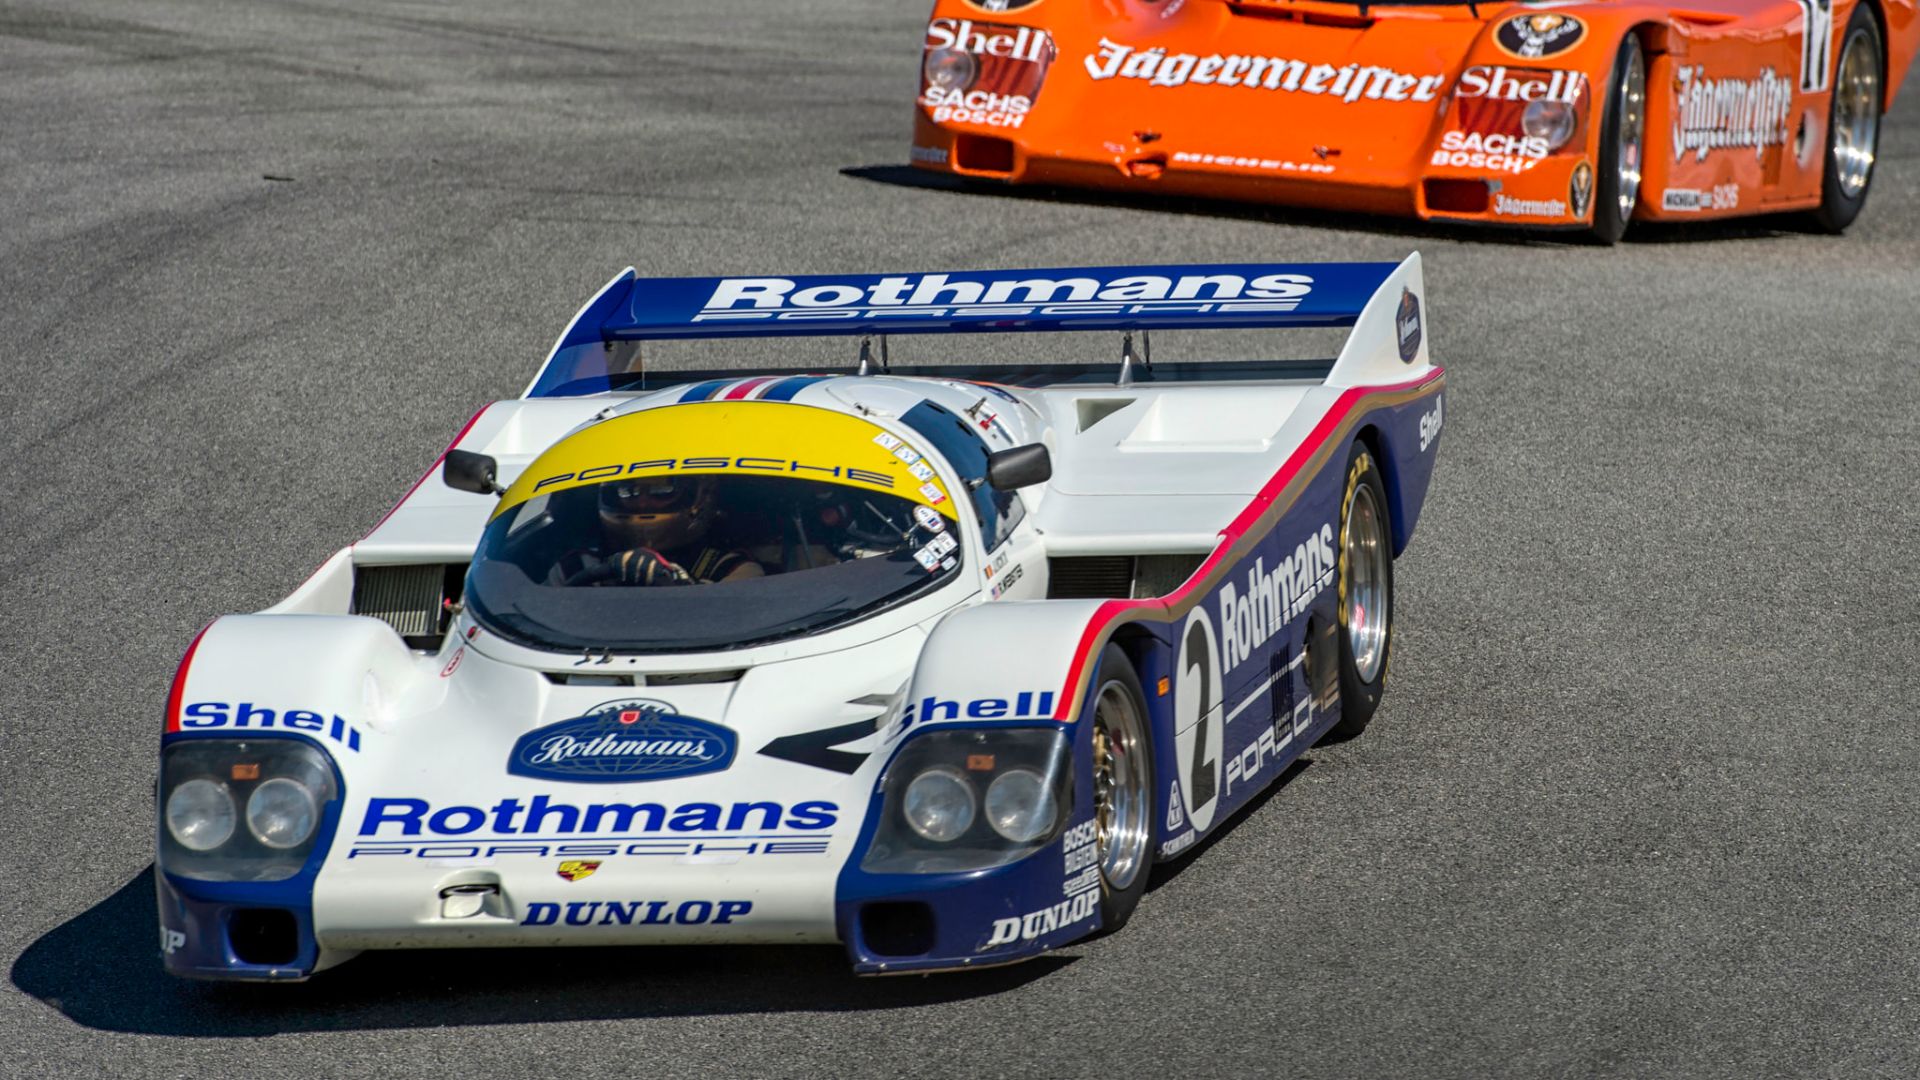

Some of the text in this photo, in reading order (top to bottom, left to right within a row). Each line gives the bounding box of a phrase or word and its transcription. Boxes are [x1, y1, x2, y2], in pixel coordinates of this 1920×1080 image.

[925, 17, 1046, 62] Shell
[924, 86, 1031, 114] SACHS
[1456, 66, 1579, 104] Shell
[933, 107, 1025, 128] BOSCH
[1173, 151, 1335, 174] MICHELIN
[1431, 150, 1523, 174] BOSCH
[1441, 131, 1550, 159] SACHS
[703, 274, 1314, 309] Rothmans
[691, 302, 1299, 322] PORSCHE
[1420, 394, 1443, 453] Shell
[533, 457, 895, 493] PORSCHE
[1219, 523, 1336, 675] Rothmans
[182, 702, 362, 753] Shell
[1186, 619, 1216, 815] 2
[530, 732, 714, 764] Rothmans
[358, 795, 839, 836] Rothmans
[347, 842, 832, 859] PORSCHE
[521, 900, 753, 926] DUNLOP
[986, 887, 1100, 945] DUNLOP
